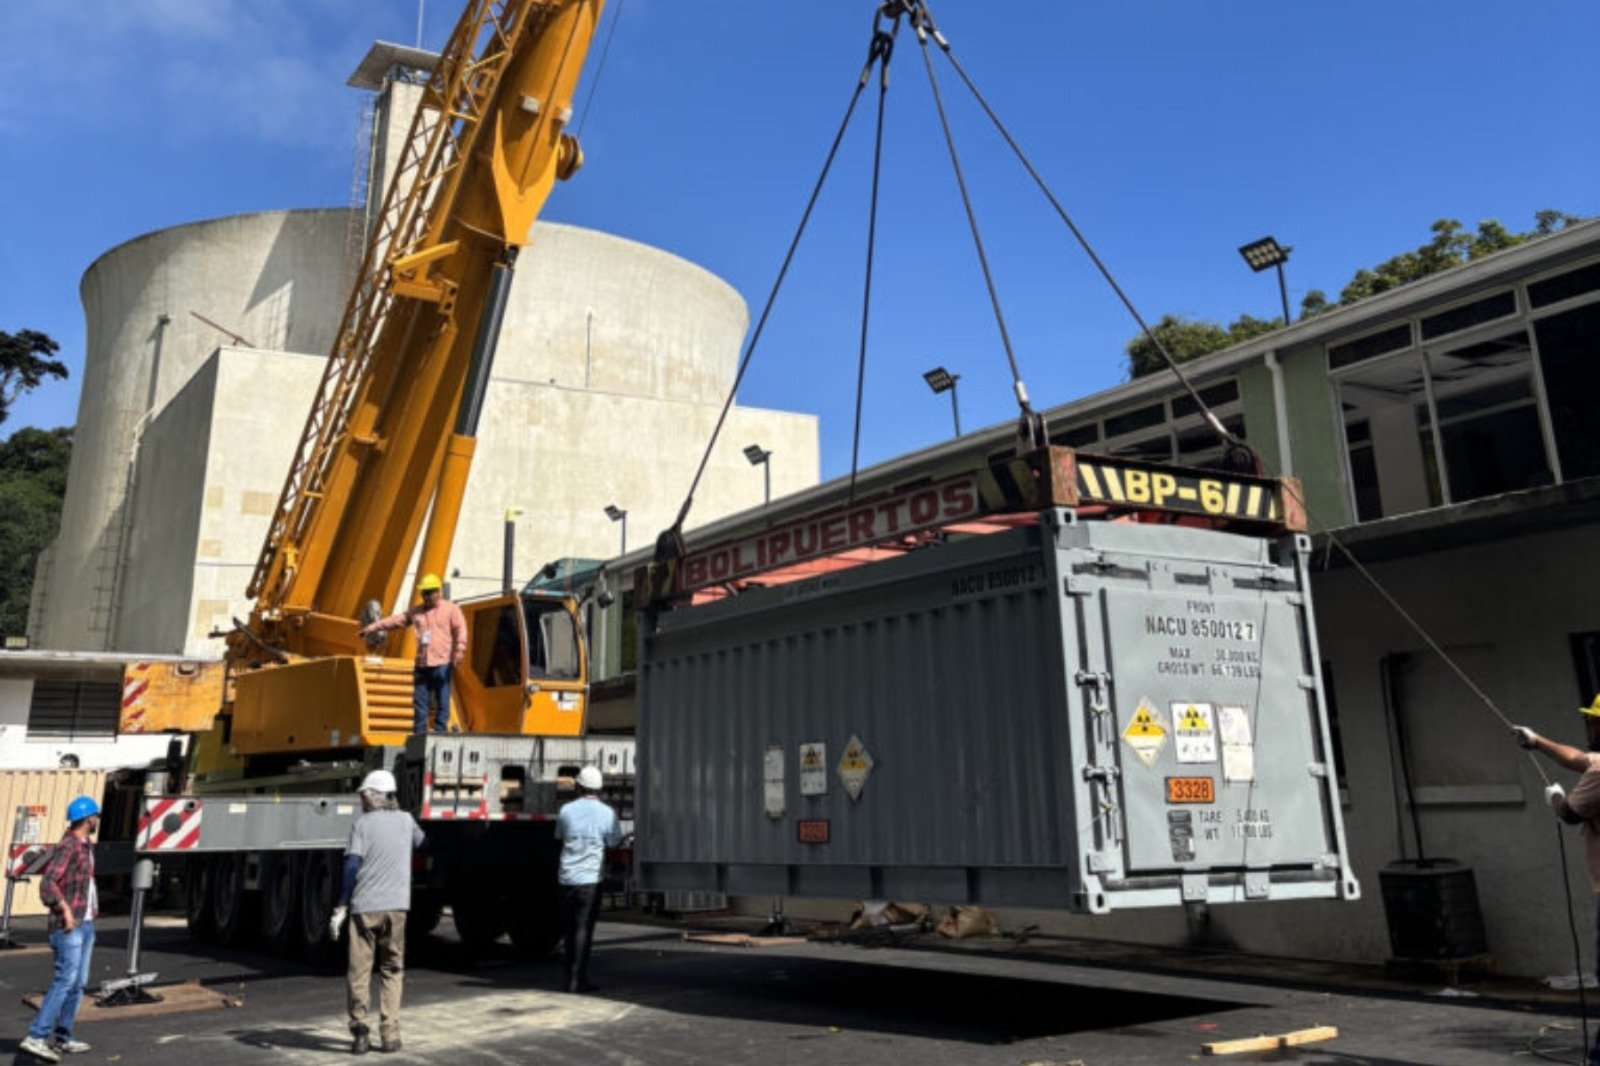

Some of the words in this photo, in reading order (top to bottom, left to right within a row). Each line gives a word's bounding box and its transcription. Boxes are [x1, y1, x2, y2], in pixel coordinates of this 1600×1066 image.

[1123, 468, 1226, 515] BP-6
[684, 479, 975, 585] BOLIPUERTOS
[1145, 616, 1187, 636] NACU
[1174, 779, 1209, 799] 3328
